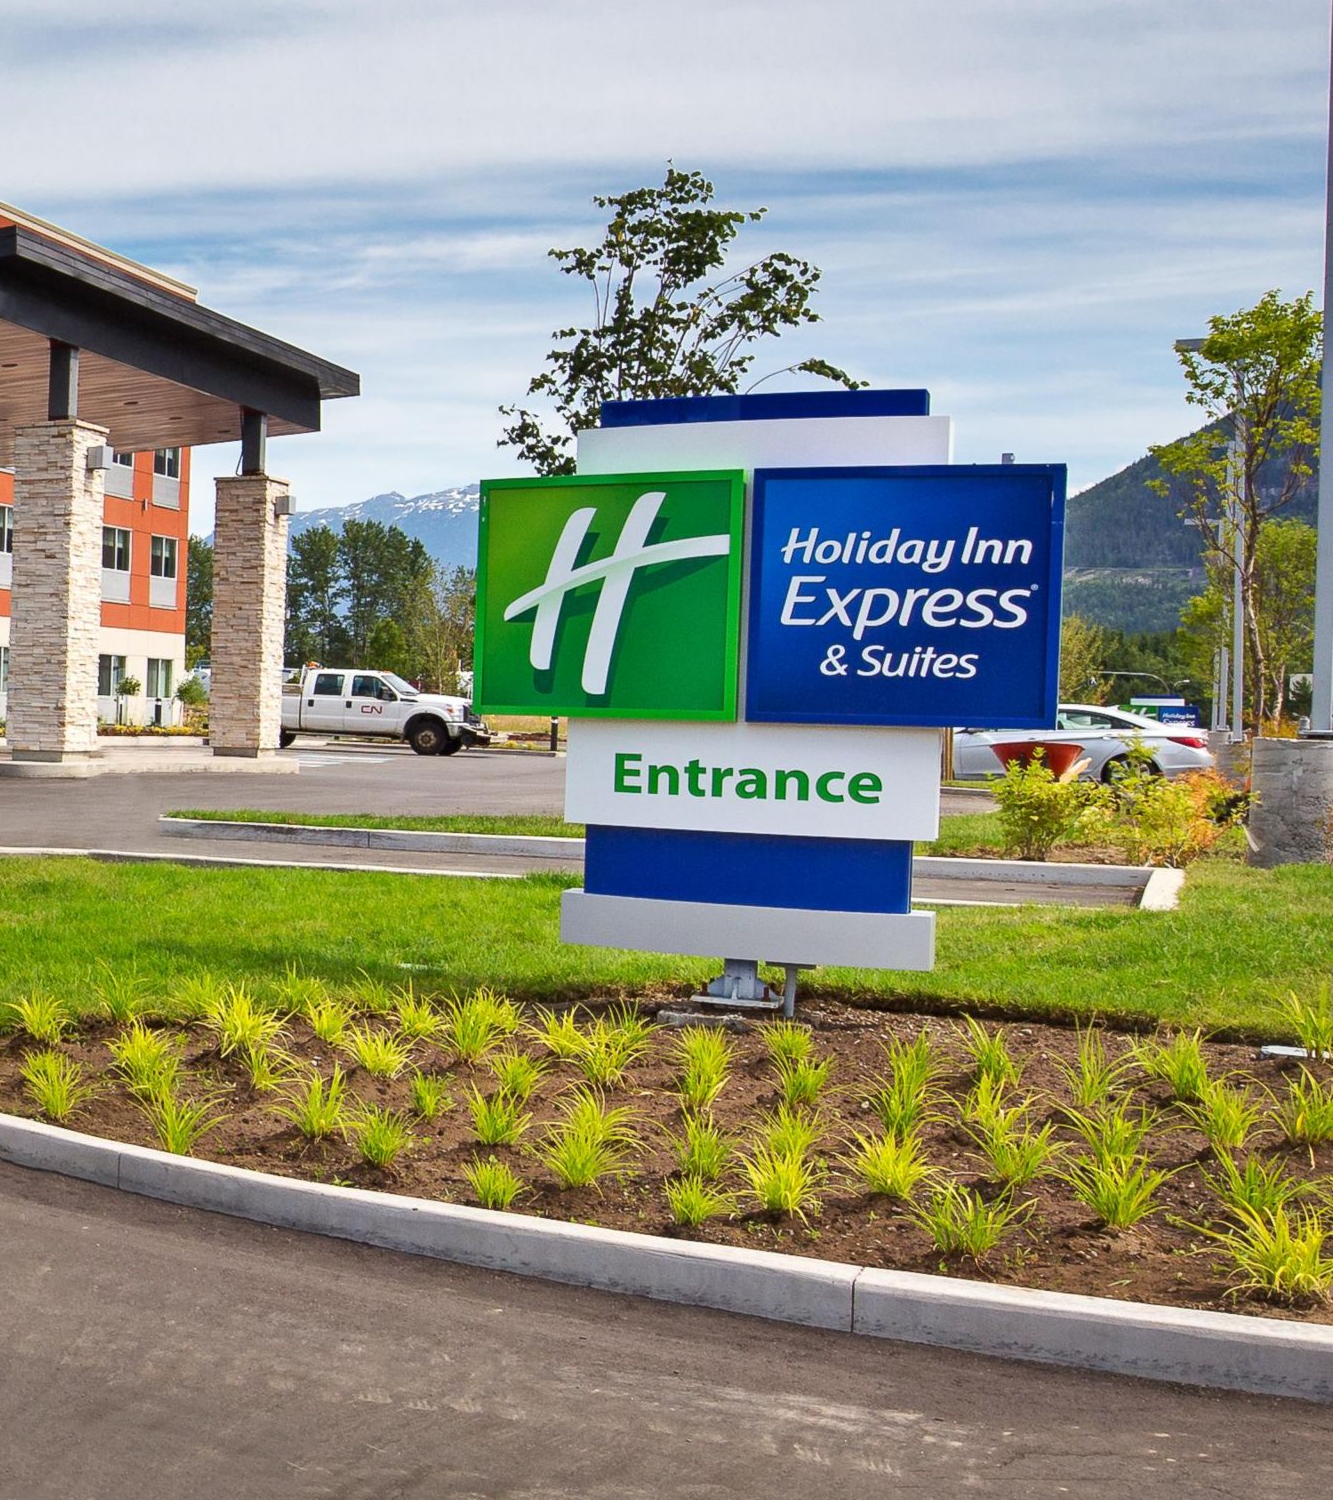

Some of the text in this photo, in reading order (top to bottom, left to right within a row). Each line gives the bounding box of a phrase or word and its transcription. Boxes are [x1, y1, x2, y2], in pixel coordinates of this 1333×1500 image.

[780, 526, 1033, 574] Holiday Inn
[780, 575, 1032, 641] Express
[819, 644, 980, 679] & Suites
[614, 752, 883, 805] Entrance
